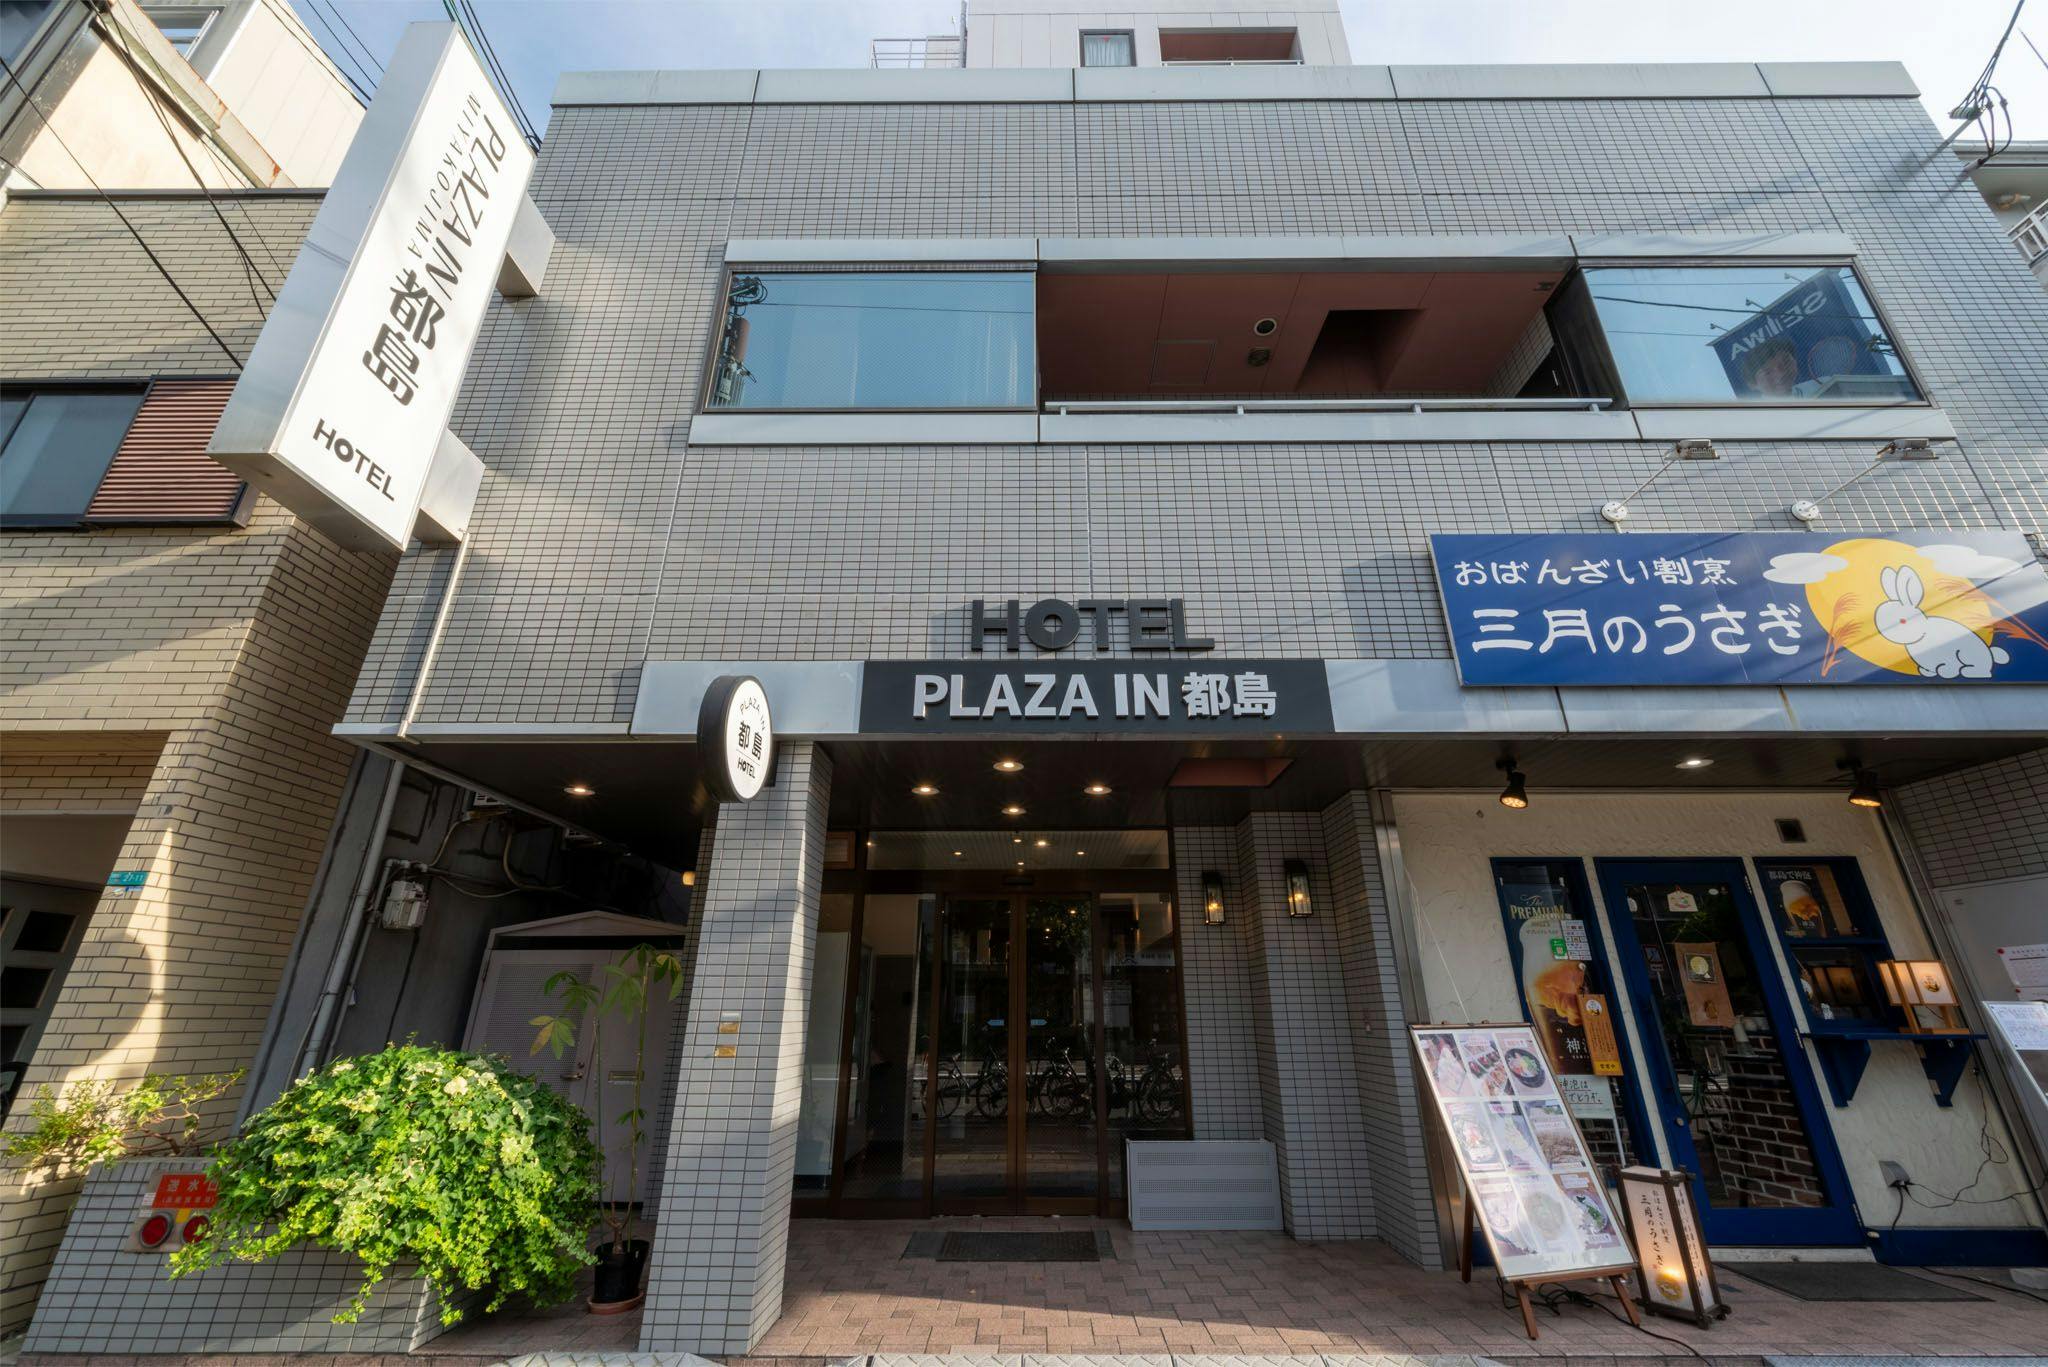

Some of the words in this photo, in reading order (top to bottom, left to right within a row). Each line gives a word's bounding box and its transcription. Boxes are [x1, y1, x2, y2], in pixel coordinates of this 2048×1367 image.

[407, 91, 482, 260] MIYAKOJIMA
[362, 267, 446, 406] 都島
[312, 417, 395, 502] HOTEL
[1454, 558, 1738, 586] おばんざい割烹
[971, 598, 1215, 651] HOTEL
[1472, 603, 1802, 655] 三月のうさぎ
[739, 696, 761, 715] PLAZA
[913, 673, 1099, 720] PLAZA
[1114, 673, 1171, 720] IN
[1181, 671, 1277, 720] 都島
[738, 720, 763, 761] 都島
[737, 756, 756, 780] HOTEL
[1510, 904, 1566, 920] PREMIUM
